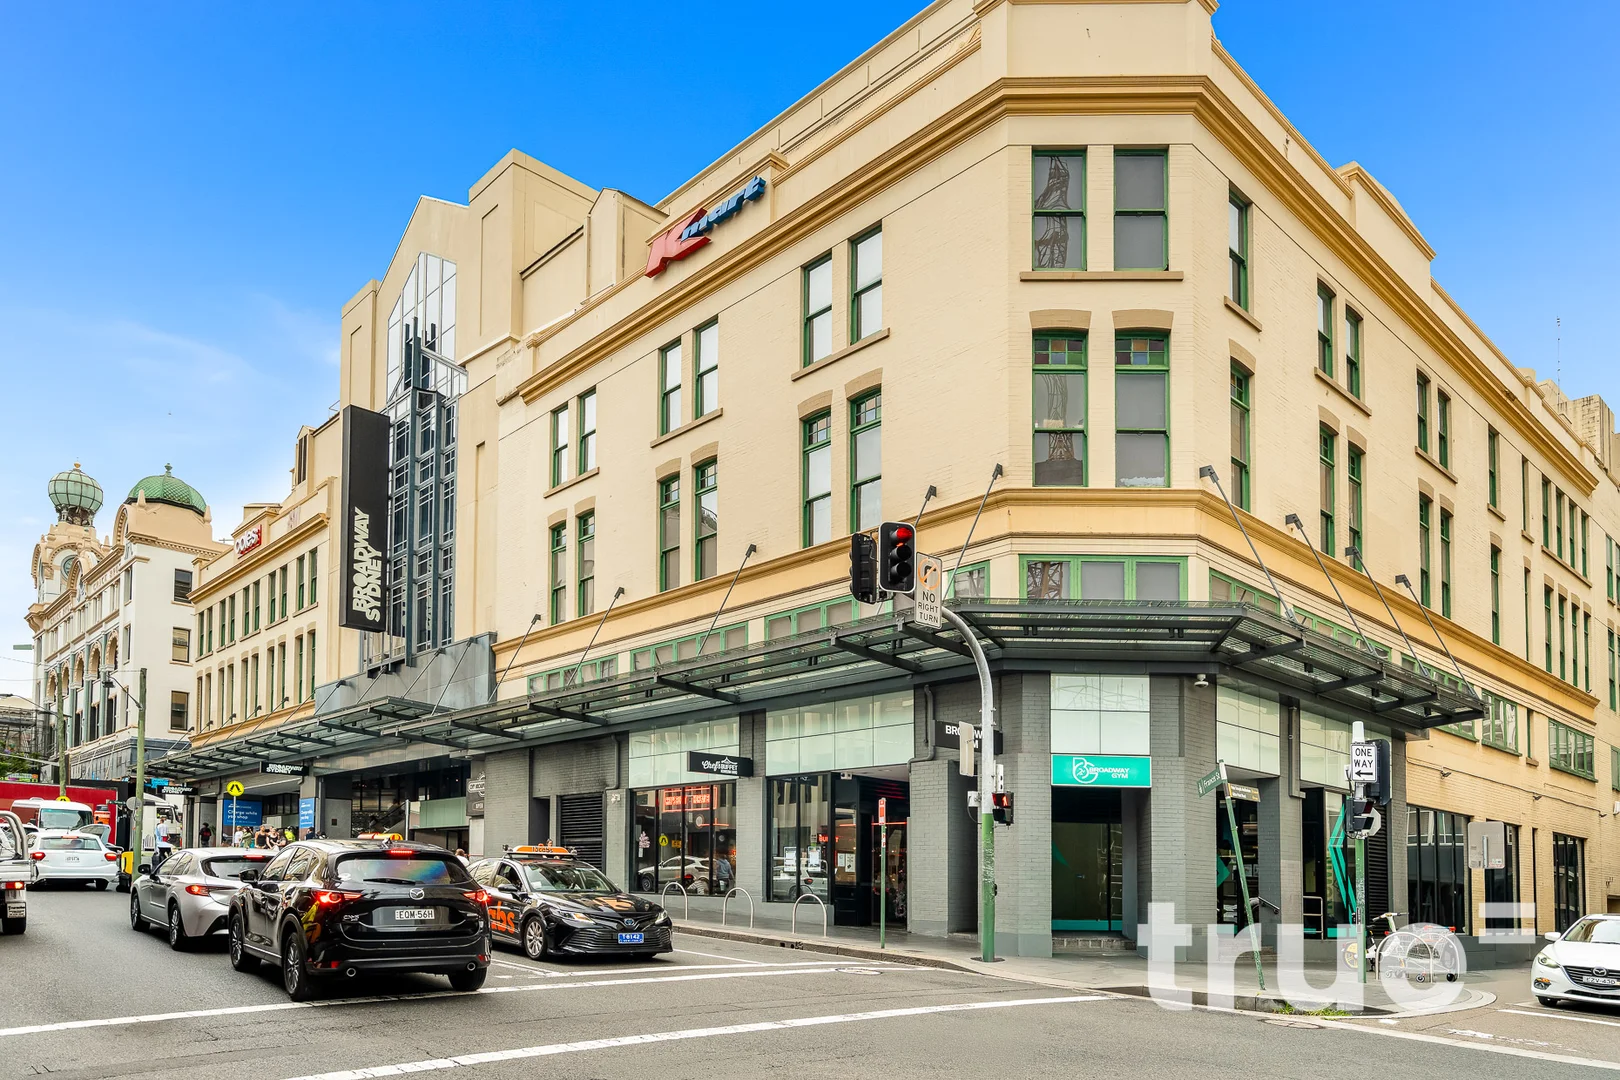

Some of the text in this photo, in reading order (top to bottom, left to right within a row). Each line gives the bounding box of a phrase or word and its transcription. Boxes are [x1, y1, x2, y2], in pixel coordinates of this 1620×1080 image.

[645, 175, 767, 278] Kmart
[353, 506, 369, 612] BROADWAY
[365, 543, 382, 622] SYDNEY
[922, 591, 936, 603] NO
[918, 602, 938, 614] RIGHT
[919, 612, 938, 623] TURN
[1355, 747, 1373, 757] ONE
[1353, 759, 1374, 768] WAY
